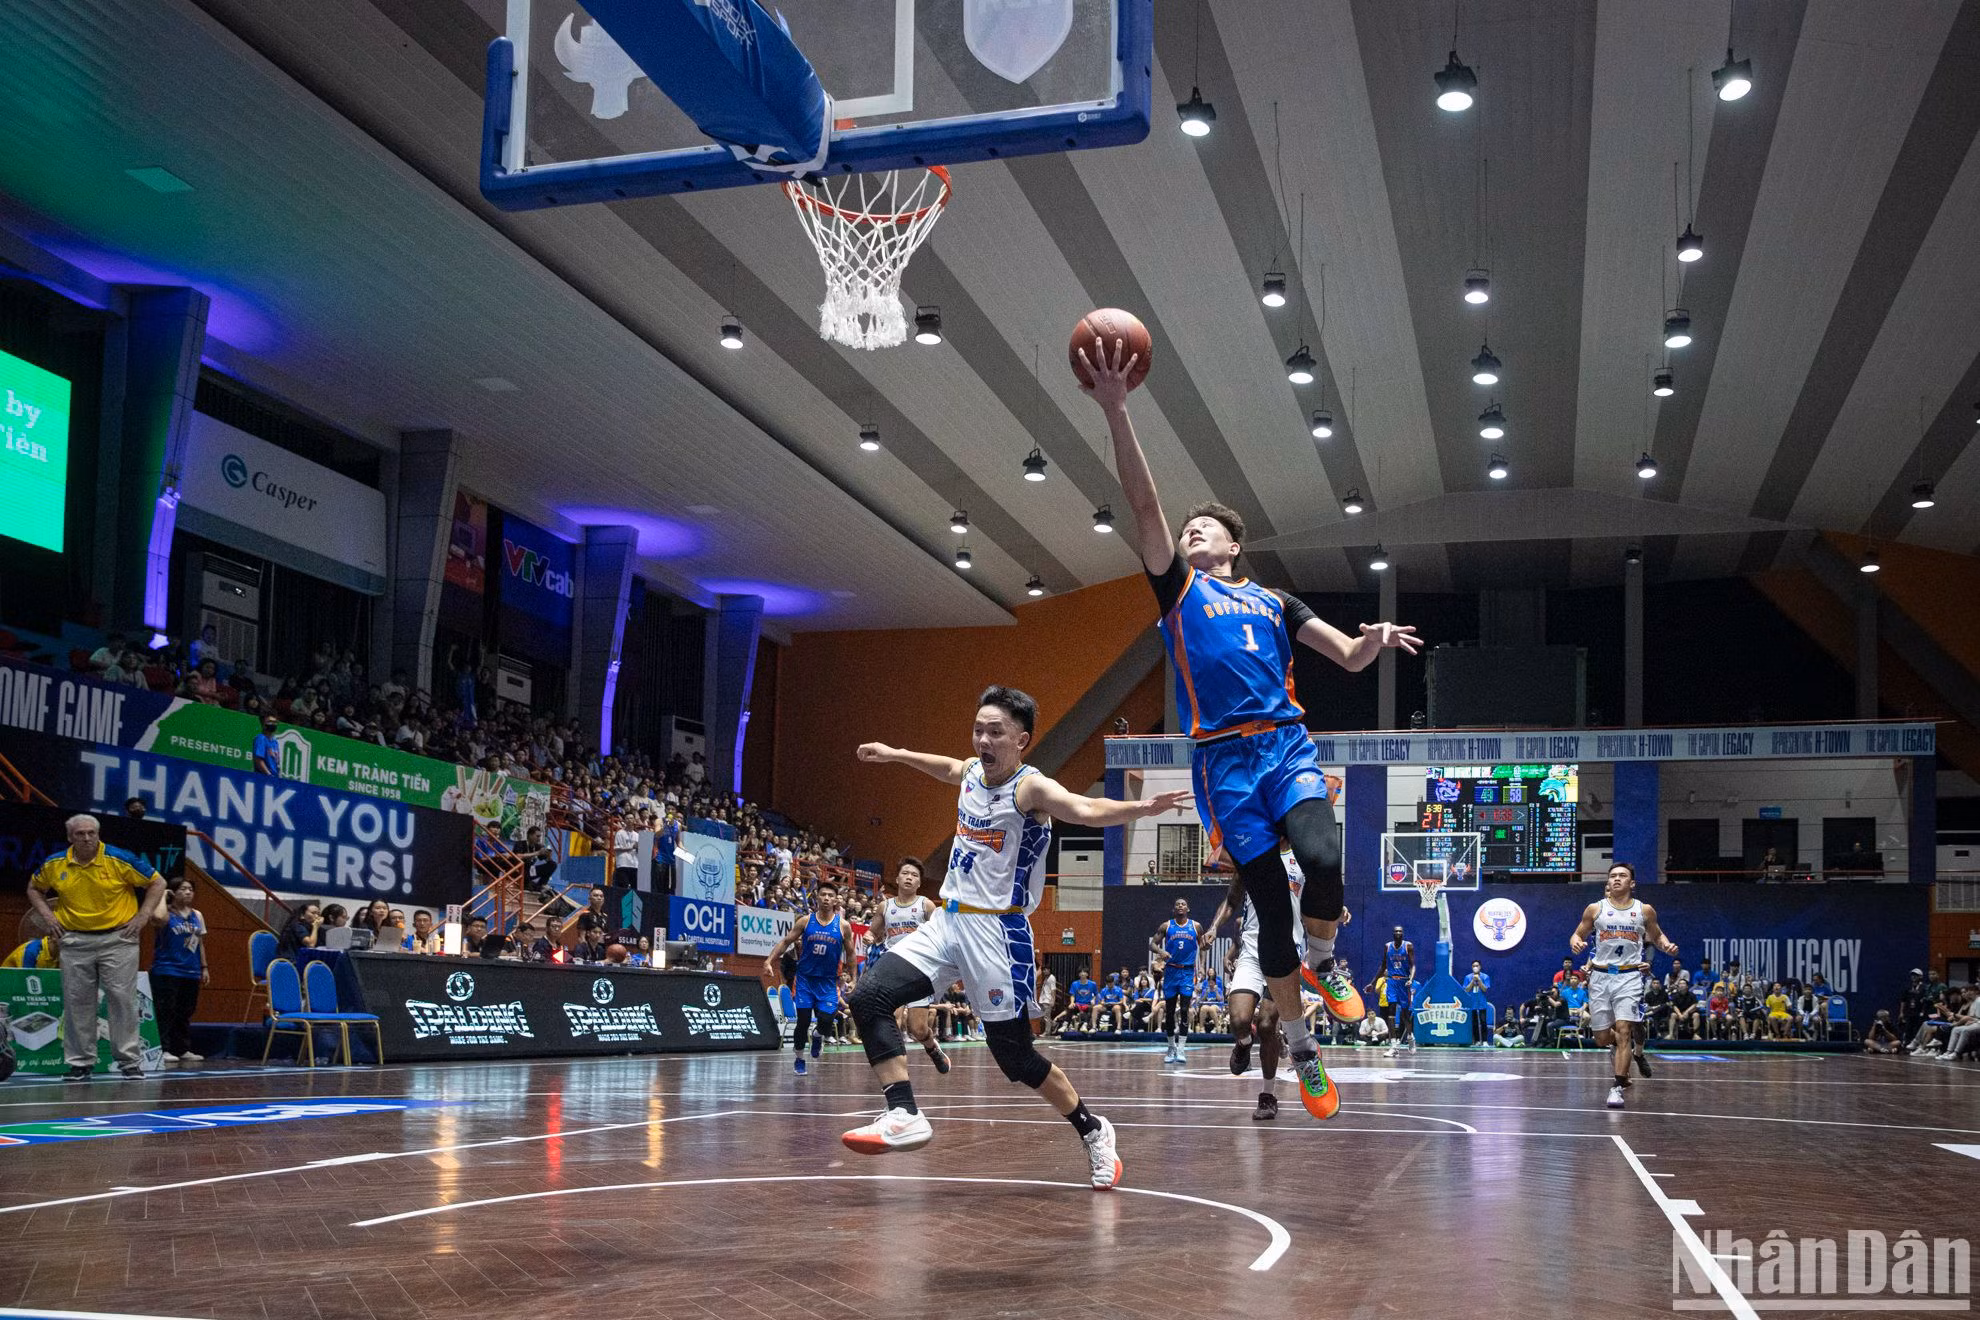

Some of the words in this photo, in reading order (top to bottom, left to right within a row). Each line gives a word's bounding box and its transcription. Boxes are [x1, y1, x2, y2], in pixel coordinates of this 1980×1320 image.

[5, 389, 42, 429] by
[252, 471, 317, 511] Casper
[1242, 624, 1260, 651] 1
[171, 735, 242, 759] PRESENTED
[1143, 742, 1174, 765] H-TOWN
[1359, 740, 1379, 760] CAPITAL
[1382, 739, 1411, 760] LEGACY
[1427, 738, 1466, 760] REPRESENTING
[1468, 738, 1501, 760] H-TOWN
[1515, 737, 1525, 759] THE
[1526, 737, 1547, 759] CAPITAL
[1549, 736, 1579, 758] LEGACY
[1597, 735, 1637, 757] REPRESENTING
[1639, 734, 1673, 757] H-TOWN
[1699, 733, 1720, 756] CAPITAL
[1722, 732, 1755, 755] LEGACY
[1772, 731, 1812, 754] REPRESENTING
[1815, 731, 1850, 753] H-TOWN
[317, 754, 349, 776] KEM
[352, 762, 398, 785] TRÀNG
[81, 751, 297, 831] THANK
[318, 795, 415, 849] YOU
[348, 780, 379, 795] SINCE
[381, 787, 401, 800] 1958
[967, 815, 992, 829] TRANG
[1421, 812, 1443, 829] 21
[684, 903, 725, 935] OCH
[740, 937, 763, 948] Supporting
[812, 943, 827, 956] 30
[1178, 941, 1185, 950] 3
[1615, 944, 1625, 957] 4
[1703, 938, 1727, 976] THE
[1729, 938, 1779, 982] CAPITAL
[1787, 938, 1862, 993] LEGACY
[405, 999, 535, 1039] SPALDING
[563, 1002, 662, 1038] SPALDING
[681, 1004, 761, 1036] SPALDING
[1418, 1010, 1467, 1023] BUFFALOES
